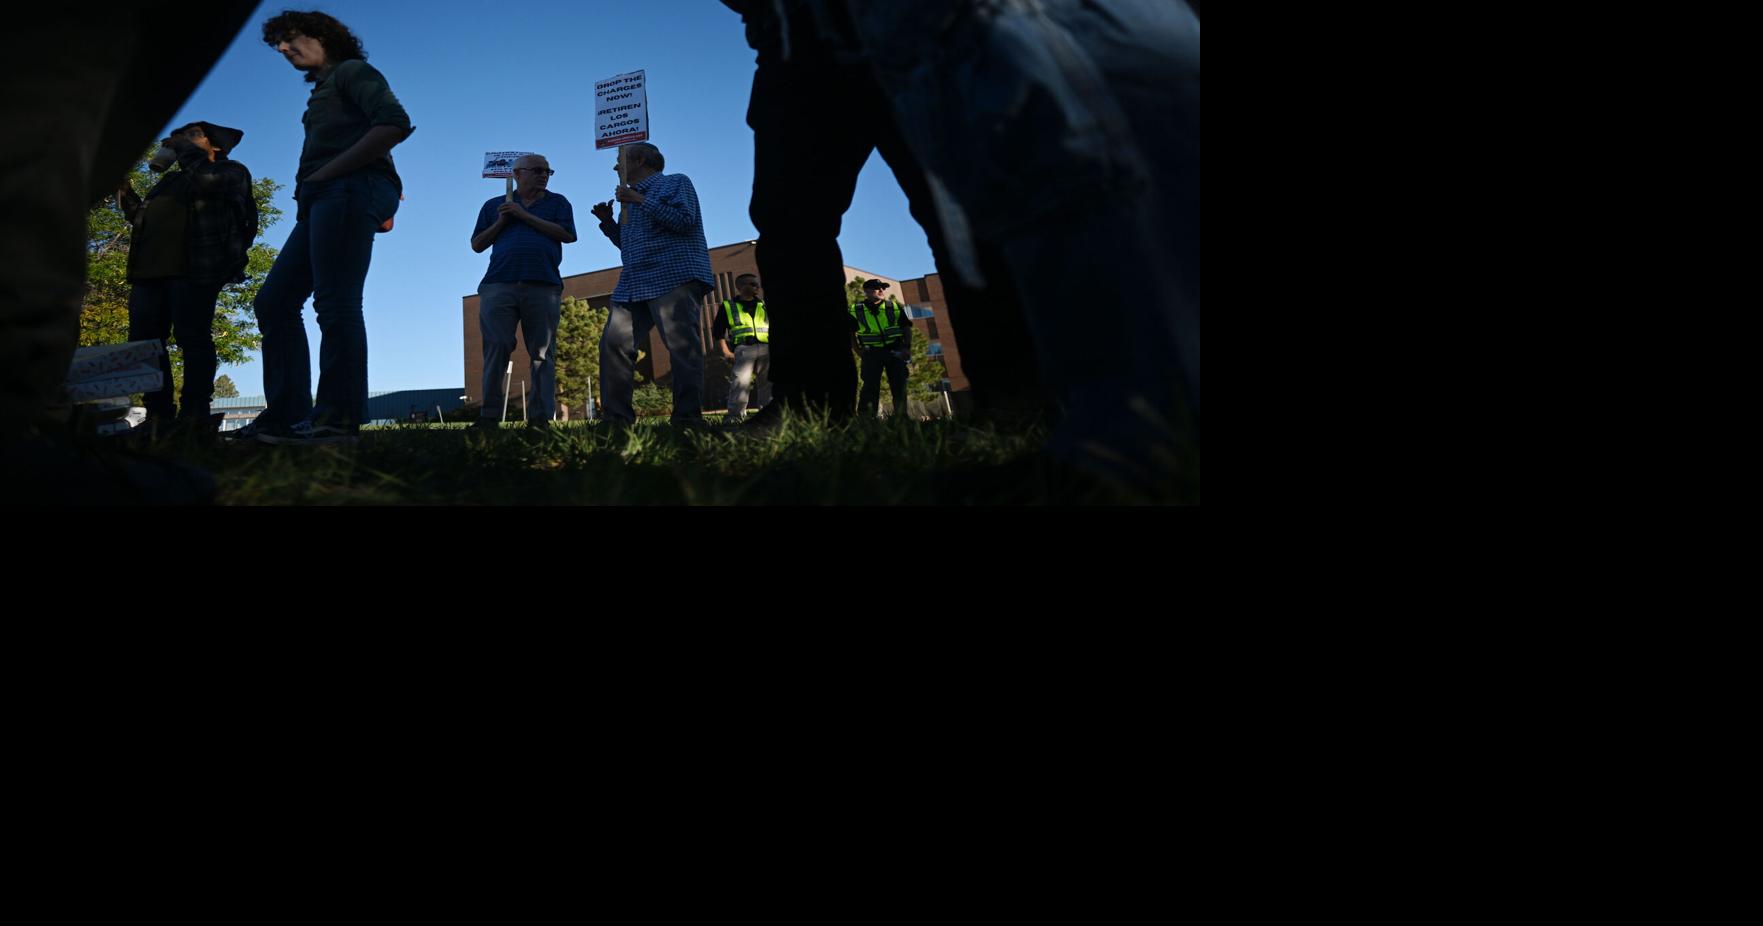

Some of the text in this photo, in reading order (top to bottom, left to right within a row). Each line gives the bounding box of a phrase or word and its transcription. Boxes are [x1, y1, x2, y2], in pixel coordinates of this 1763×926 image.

[597, 74, 642, 90] DROP THE
[597, 83, 642, 97] CHARGES
[606, 93, 632, 102] NOW!
[611, 113, 628, 121] LOS
[600, 118, 640, 131] CARGOS
[602, 127, 639, 137] AHORA!
